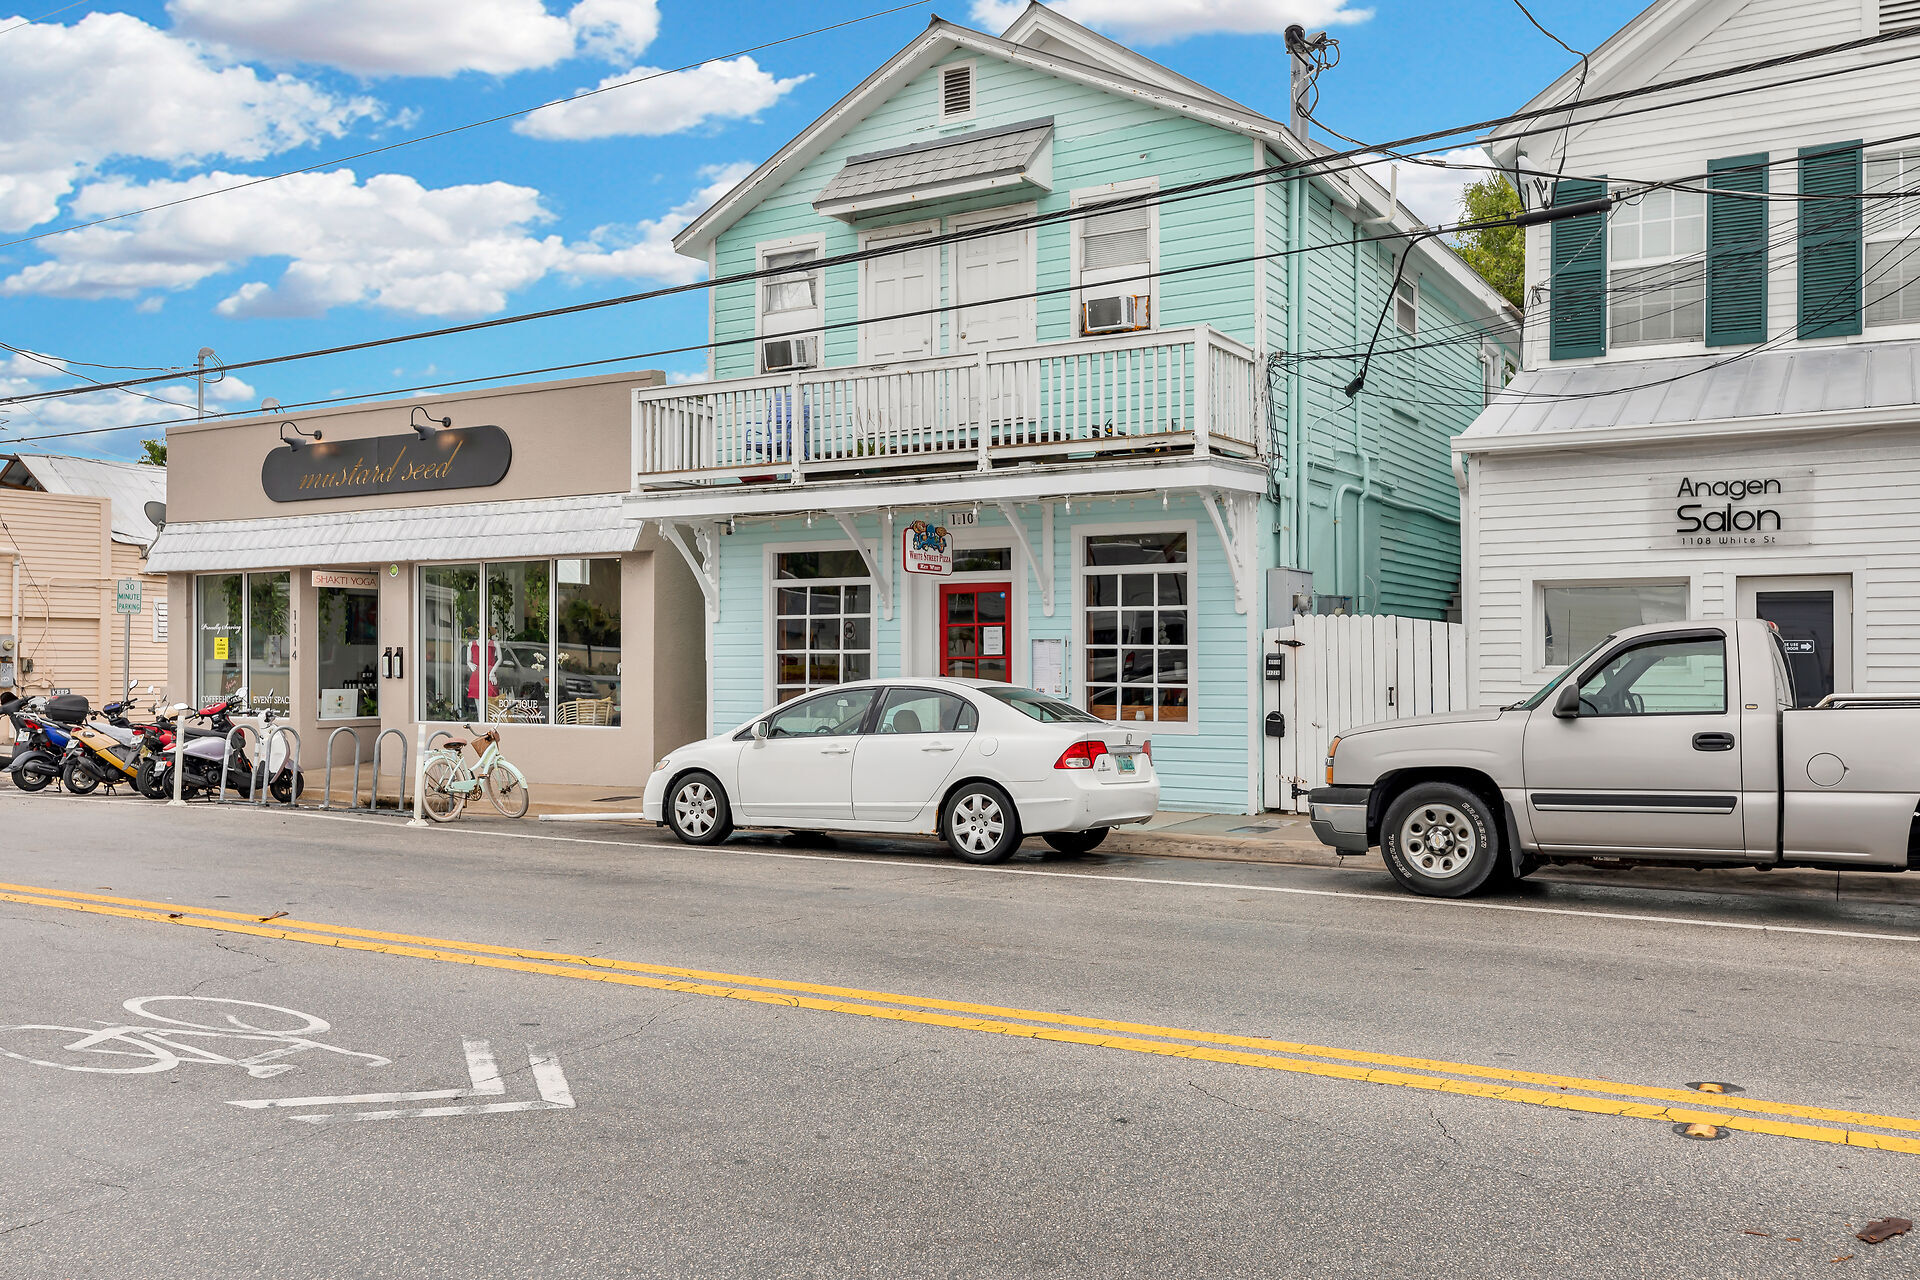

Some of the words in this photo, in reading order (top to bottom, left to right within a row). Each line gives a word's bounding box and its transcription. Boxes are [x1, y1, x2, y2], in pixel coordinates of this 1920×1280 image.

[299, 444, 407, 490] mustard
[401, 439, 464, 481] seed
[1677, 477, 1781, 500] Anagen
[1677, 503, 1781, 533] Salon
[1682, 537, 1711, 545] 1108
[1718, 536, 1756, 545] White
[1764, 535, 1776, 544] St
[924, 552, 939, 563] STREET
[315, 574, 348, 585] SHAKTI
[350, 576, 377, 587] YOGA
[125, 583, 135, 591] 30
[118, 593, 141, 601] MINUTE
[119, 603, 140, 611] PARKING
[253, 695, 272, 704] EVENT
